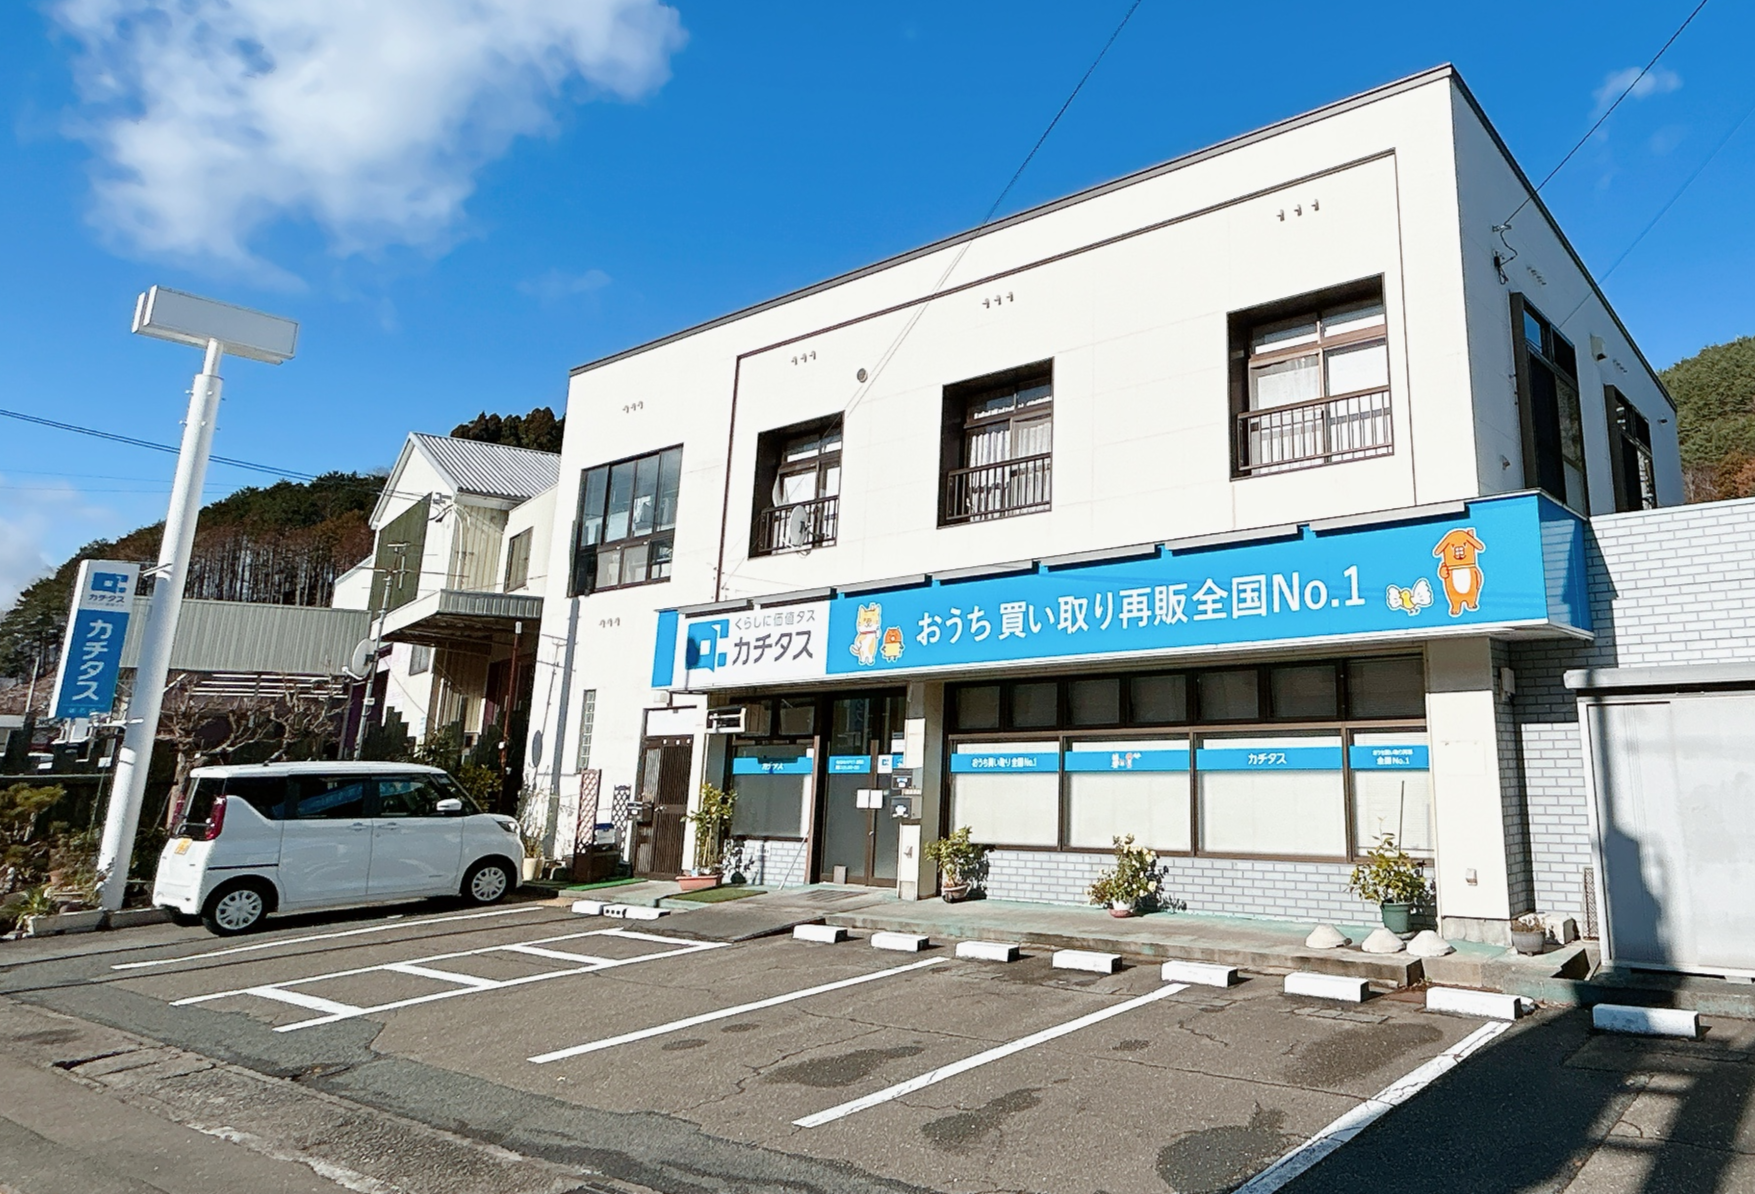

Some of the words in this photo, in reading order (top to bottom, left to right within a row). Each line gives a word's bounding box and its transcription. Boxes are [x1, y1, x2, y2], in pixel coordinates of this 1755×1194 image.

[735, 610, 815, 630] くらしに価値タス
[916, 565, 1366, 645] おうち買い取り再販全国No.1
[72, 619, 114, 701] カチタス
[732, 630, 813, 666] カチタス
[1247, 753, 1287, 765] カチタス
